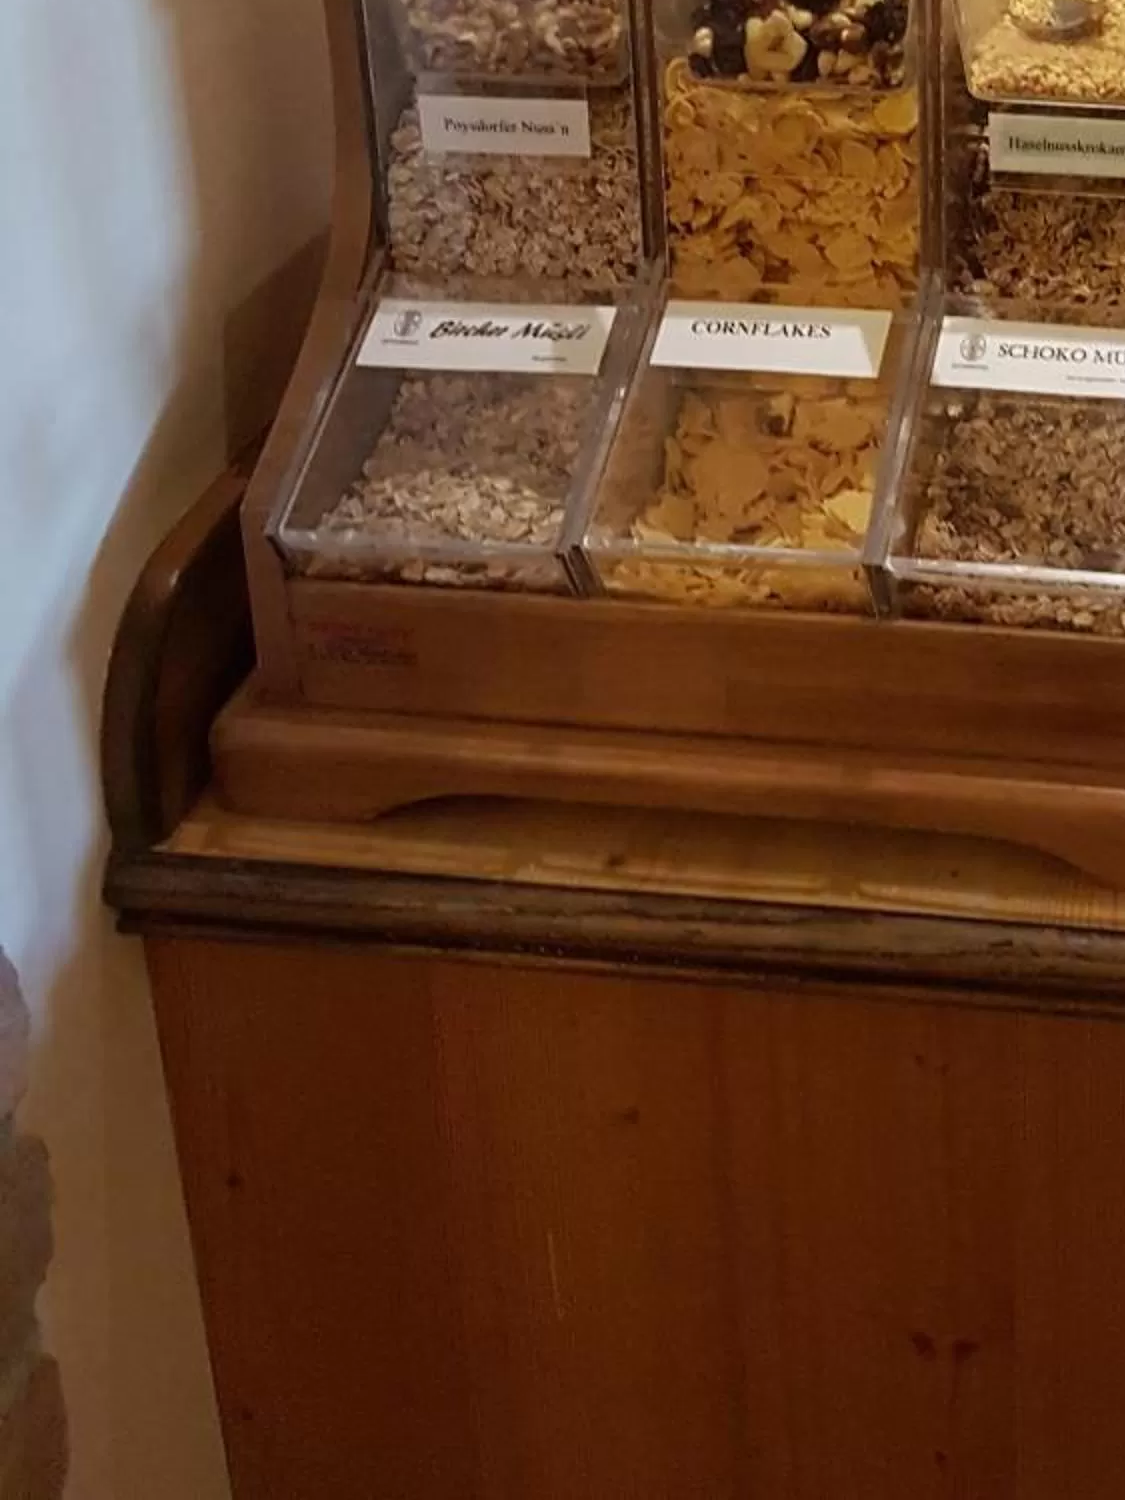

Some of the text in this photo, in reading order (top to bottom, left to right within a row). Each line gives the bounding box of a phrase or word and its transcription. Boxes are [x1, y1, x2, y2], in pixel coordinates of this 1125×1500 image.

[429, 320, 507, 340] Bircher
[690, 318, 832, 339] CORNFLAKES
[998, 342, 1087, 365] SCHOKO
